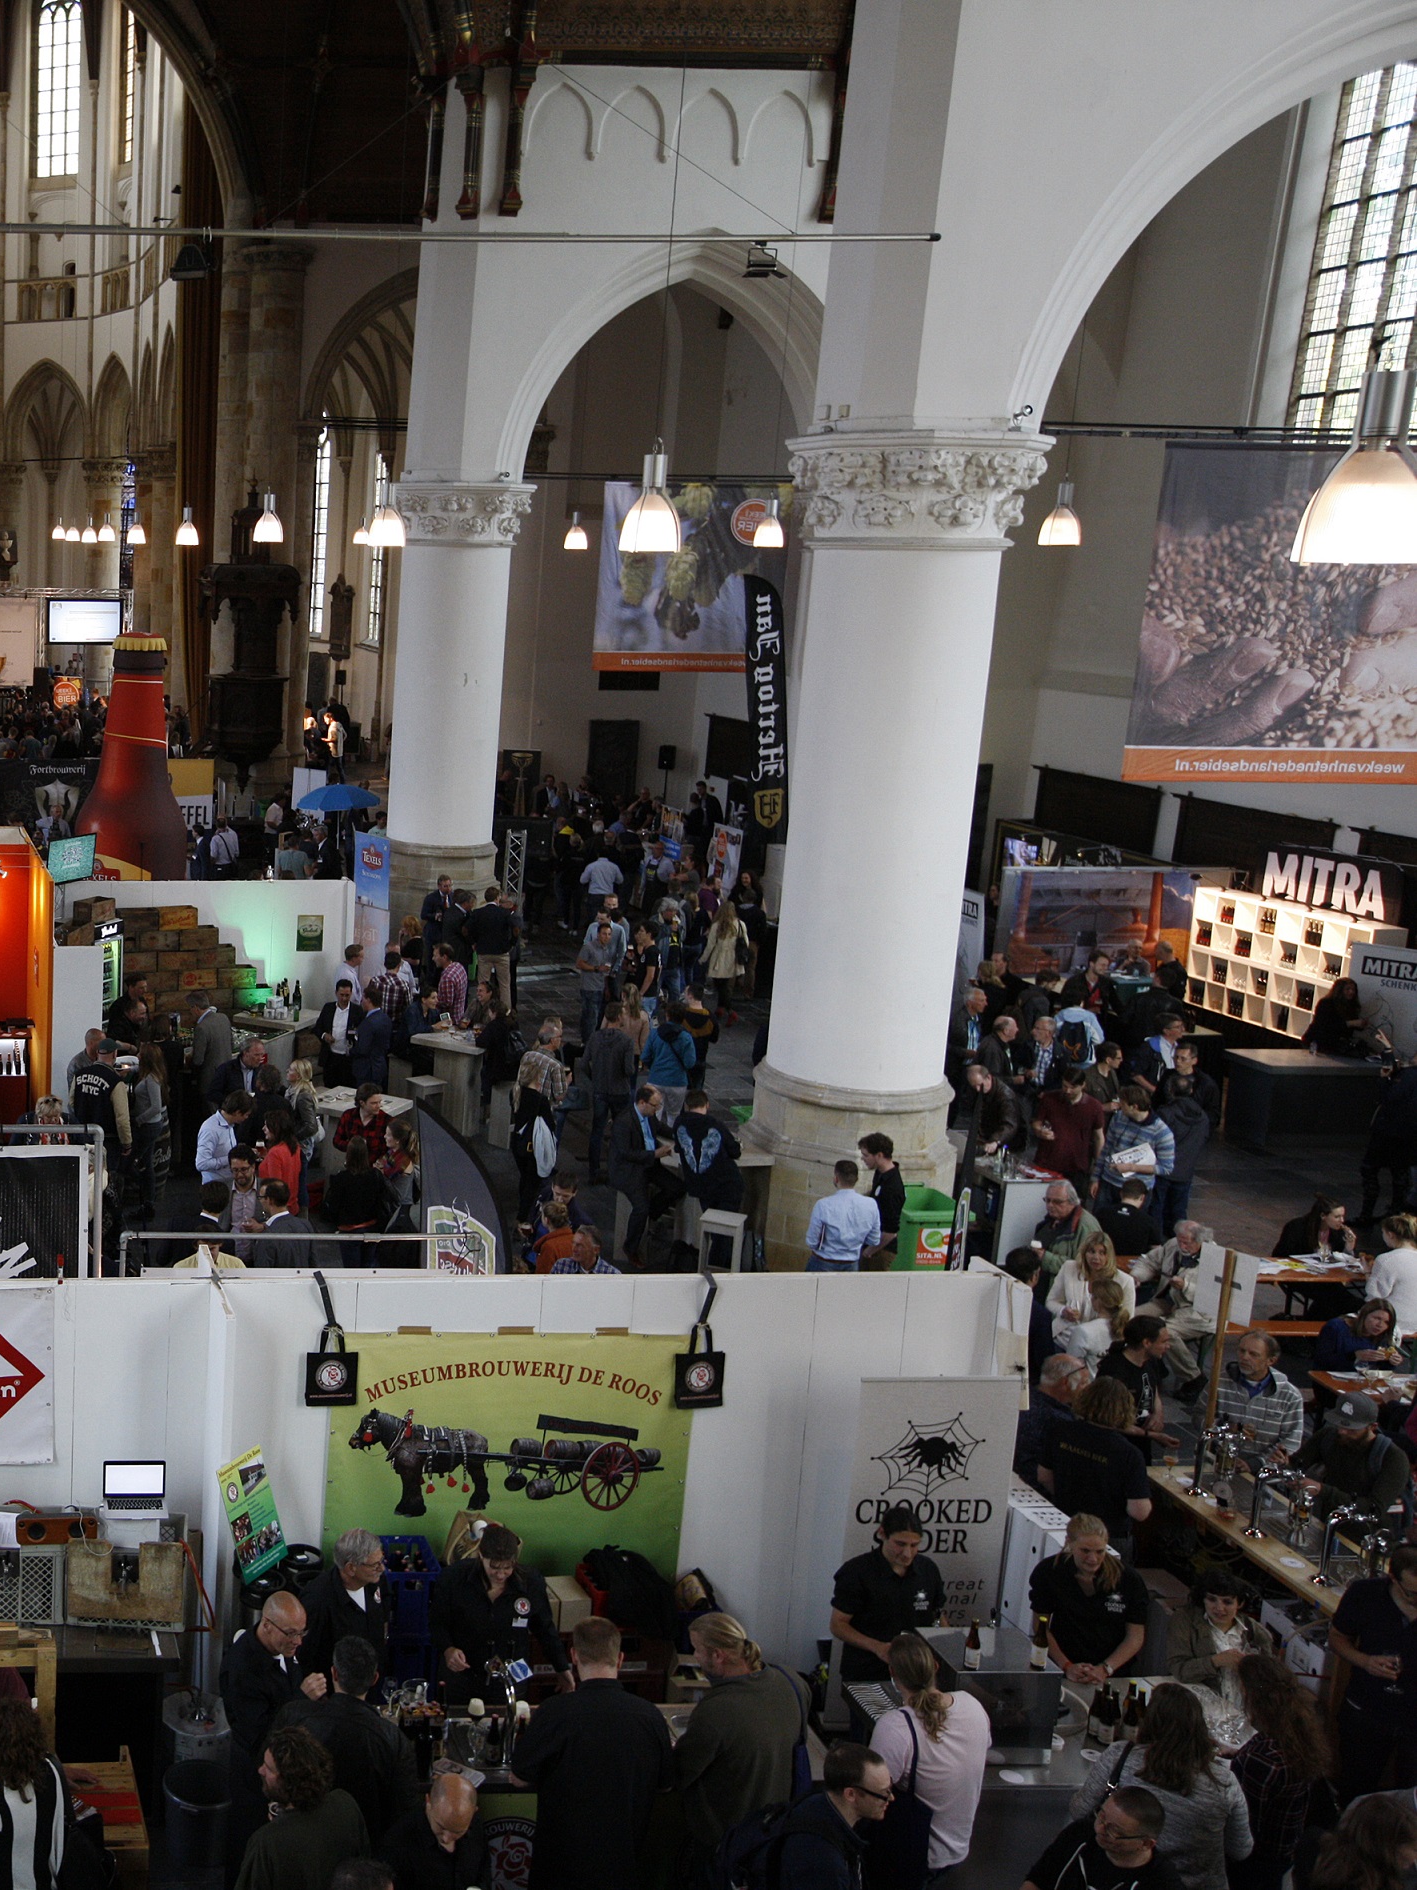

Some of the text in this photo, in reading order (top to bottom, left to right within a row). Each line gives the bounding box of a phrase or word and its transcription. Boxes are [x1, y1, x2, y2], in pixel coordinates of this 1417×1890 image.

[57, 695, 77, 703] BIER
[29, 764, 86, 775] Fortbrouwerij
[1262, 851, 1385, 921] MITRA
[76, 1074, 110, 1091] SCHOTT
[82, 1084, 100, 1096] NYC
[364, 1360, 575, 1403] MUSEUMBROUWERIJ
[577, 1366, 605, 1386] DE
[608, 1373, 663, 1406] ROOS
[855, 1498, 992, 1525] CROKED
[872, 1529, 968, 1554] SDER
